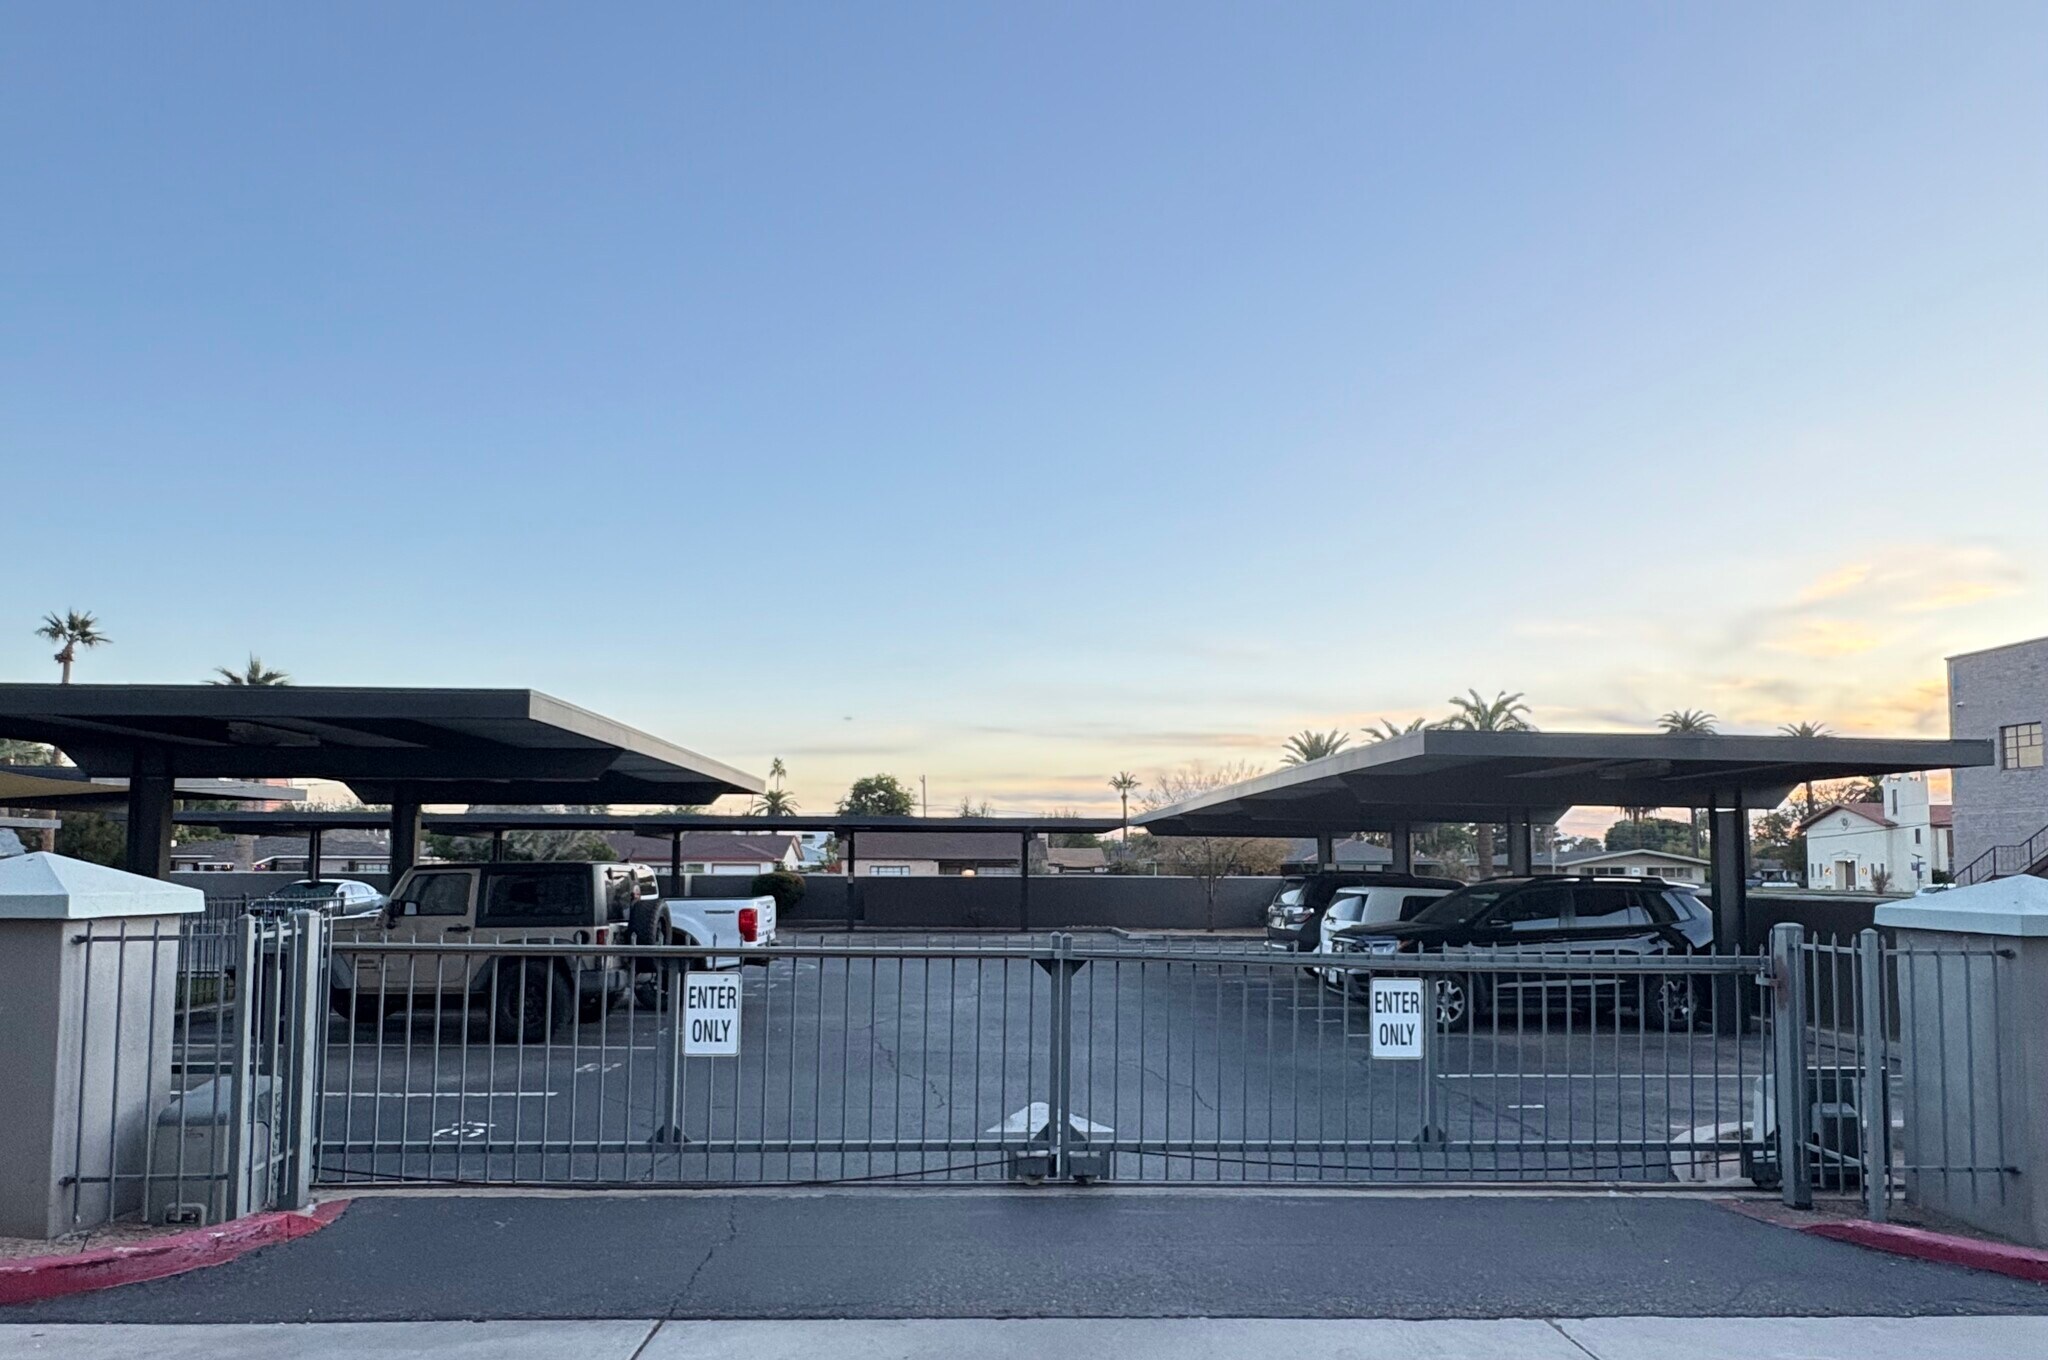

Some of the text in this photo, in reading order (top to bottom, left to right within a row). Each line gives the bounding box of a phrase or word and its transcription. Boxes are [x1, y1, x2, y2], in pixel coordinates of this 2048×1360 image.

[688, 986, 737, 1009] ENTER
[1375, 991, 1420, 1014] ENTER
[692, 1018, 731, 1043] ONLY
[1380, 1022, 1415, 1047] ONLY
